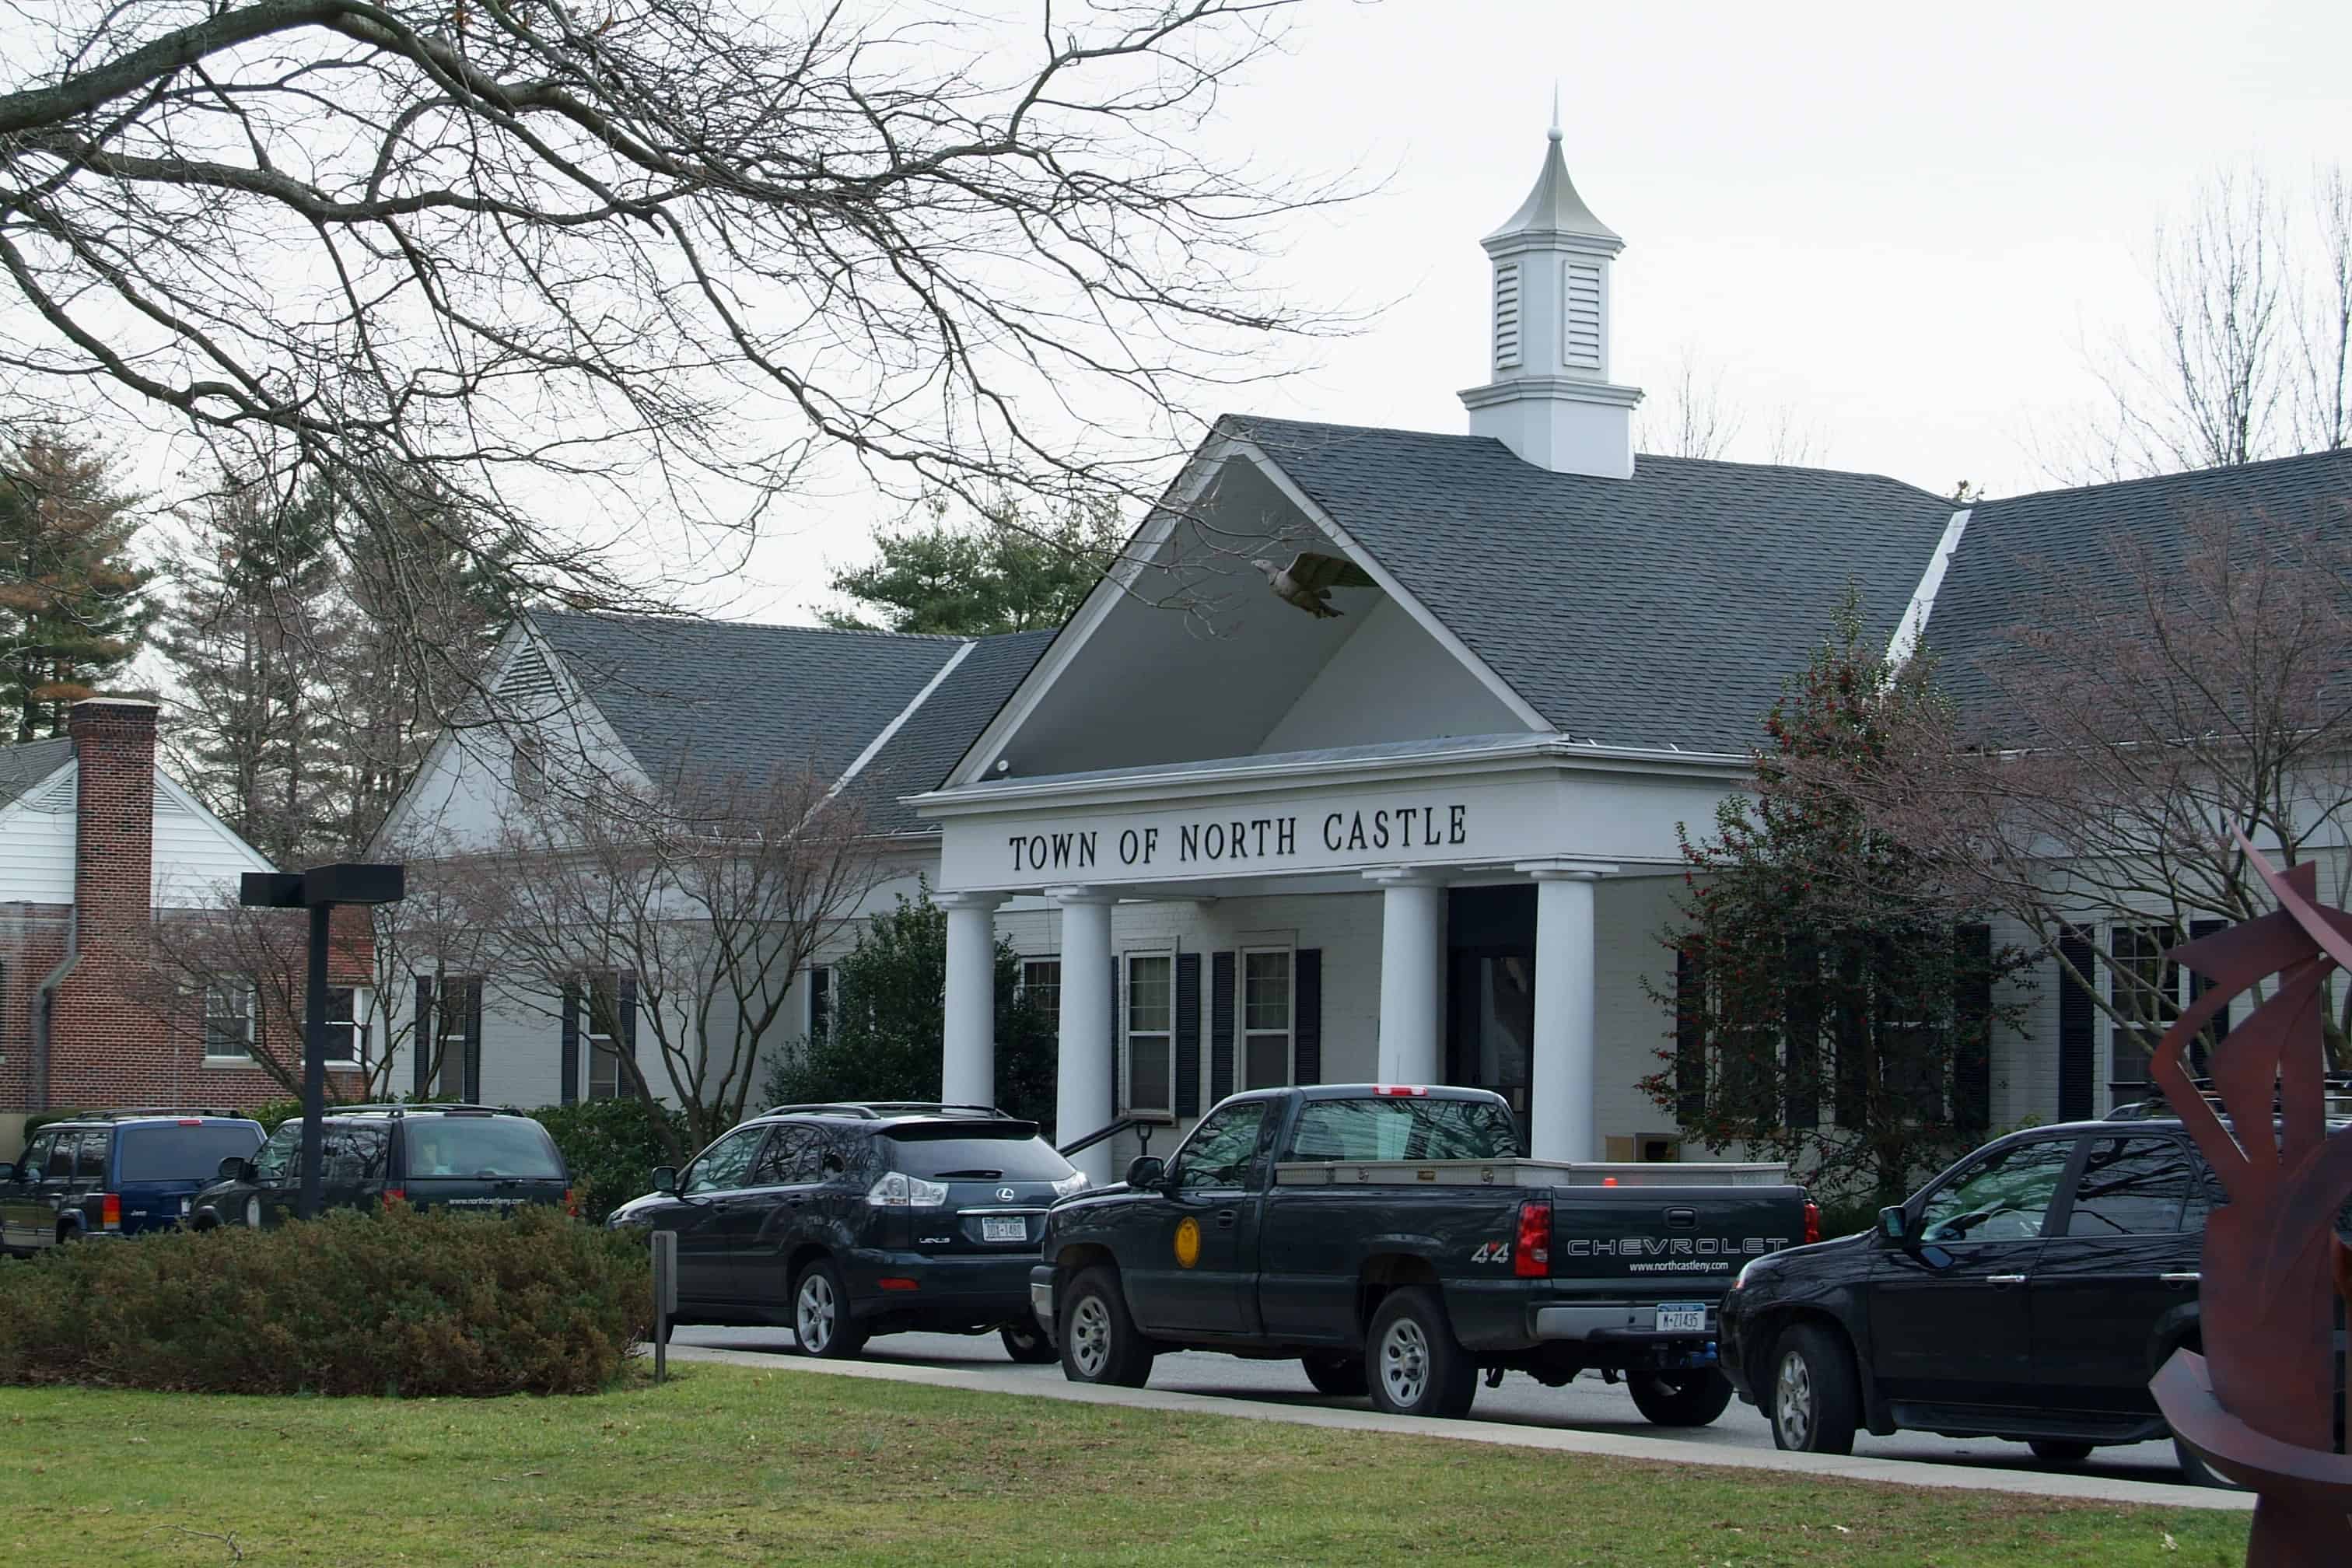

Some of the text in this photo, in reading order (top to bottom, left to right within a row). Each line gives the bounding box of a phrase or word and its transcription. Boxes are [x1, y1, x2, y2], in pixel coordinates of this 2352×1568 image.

[1010, 804, 1466, 871] TOWN OF NORTH CASTLE
[1567, 1237, 1789, 1256] CHEVROLET
[1629, 1260, 1729, 1272] www.northcastleny.com
